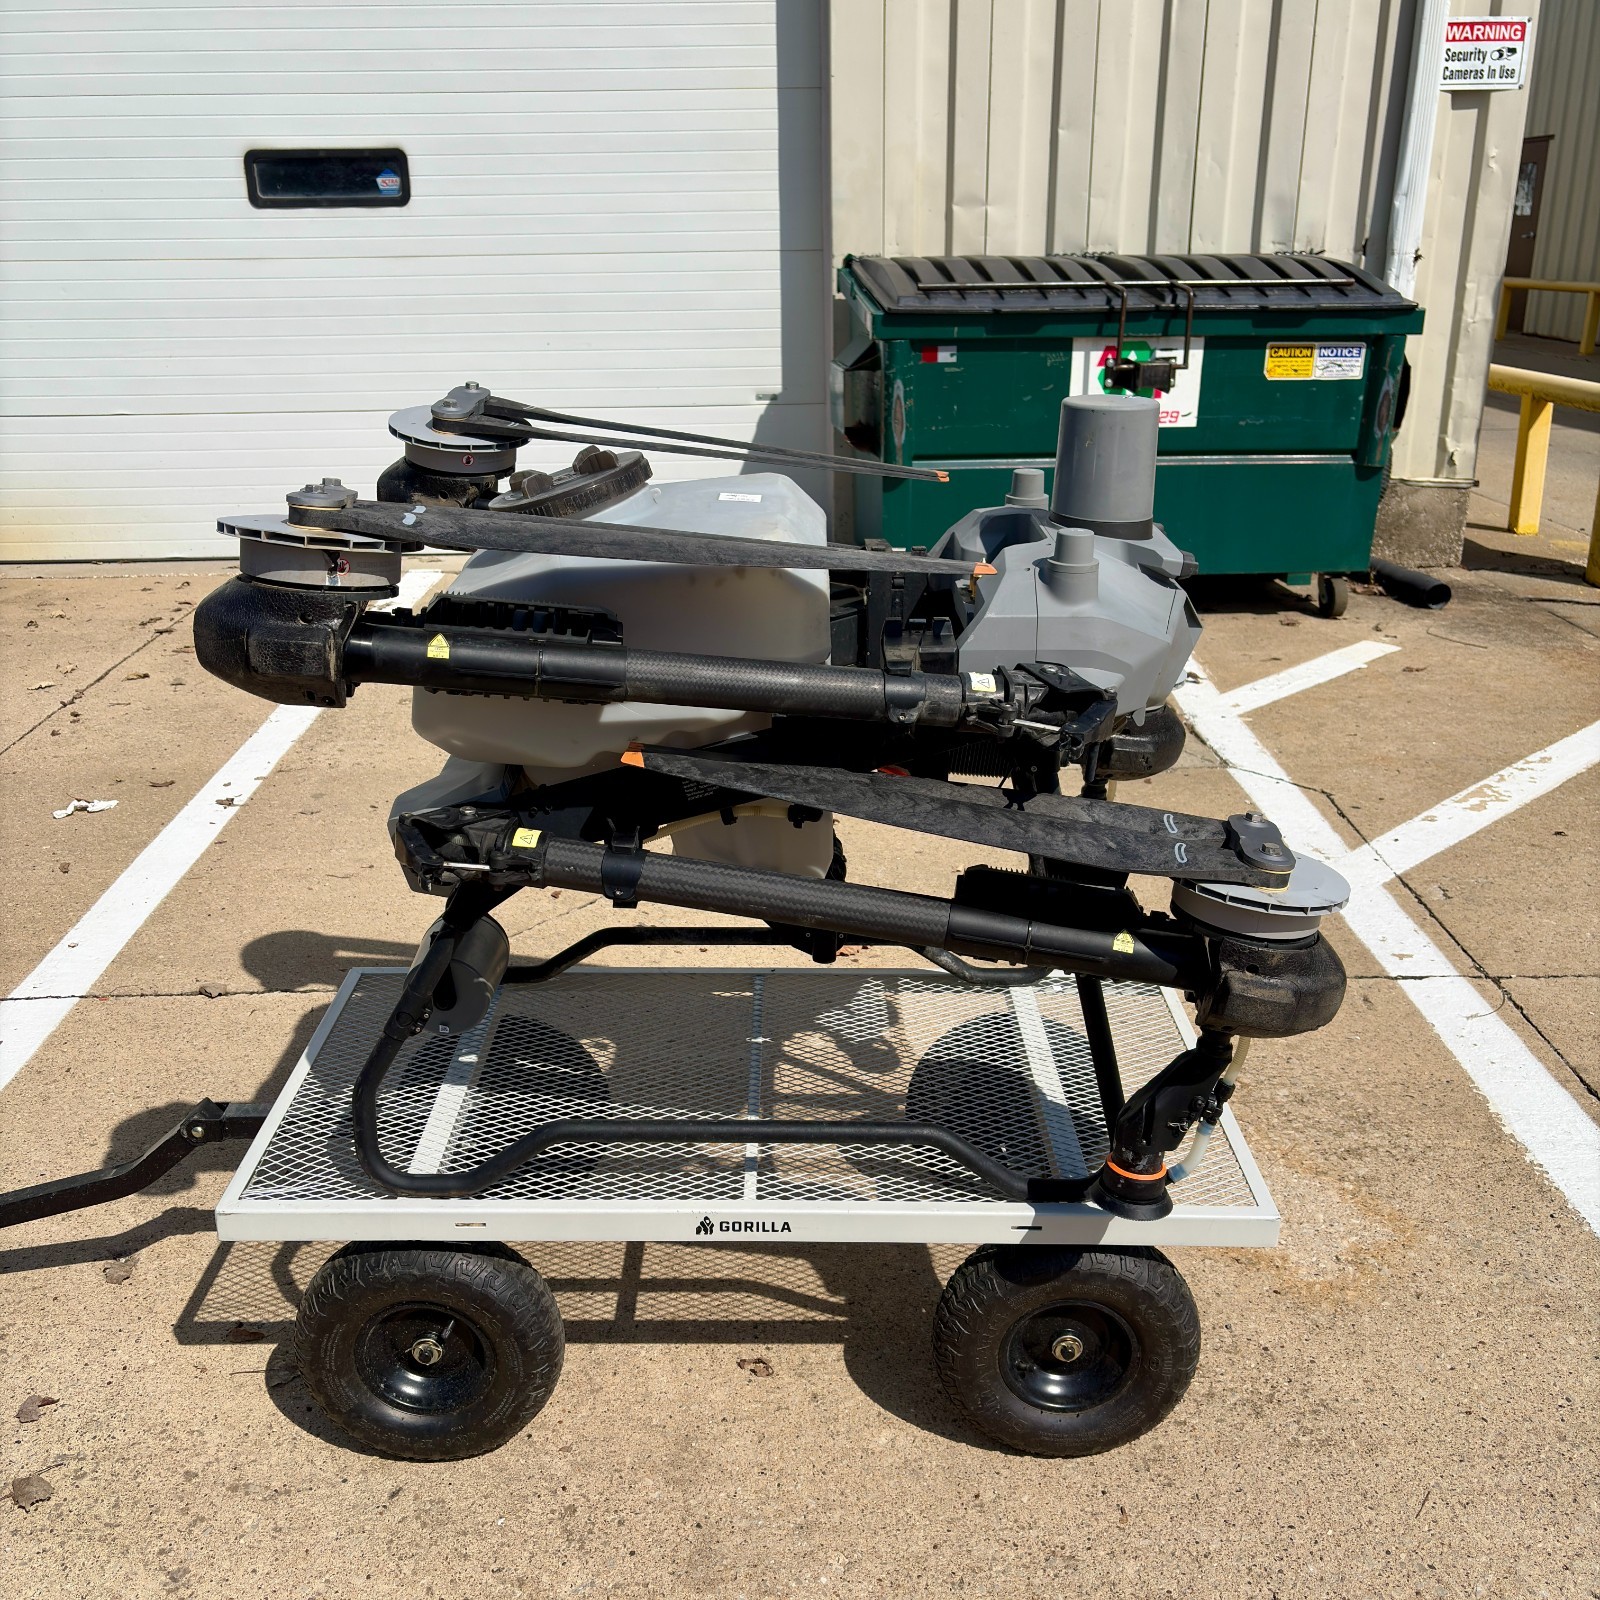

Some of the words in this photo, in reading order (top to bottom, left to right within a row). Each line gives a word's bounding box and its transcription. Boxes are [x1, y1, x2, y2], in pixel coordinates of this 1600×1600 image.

[1448, 25, 1521, 40] WARNING
[1445, 48, 1487, 64] Security
[1443, 66, 1484, 80] Cameras
[1487, 65, 1496, 79] In
[1499, 65, 1515, 79] Use
[1271, 348, 1311, 357] CAUTION
[1320, 348, 1360, 357] NOTICE
[719, 1221, 792, 1232] GORILLA
